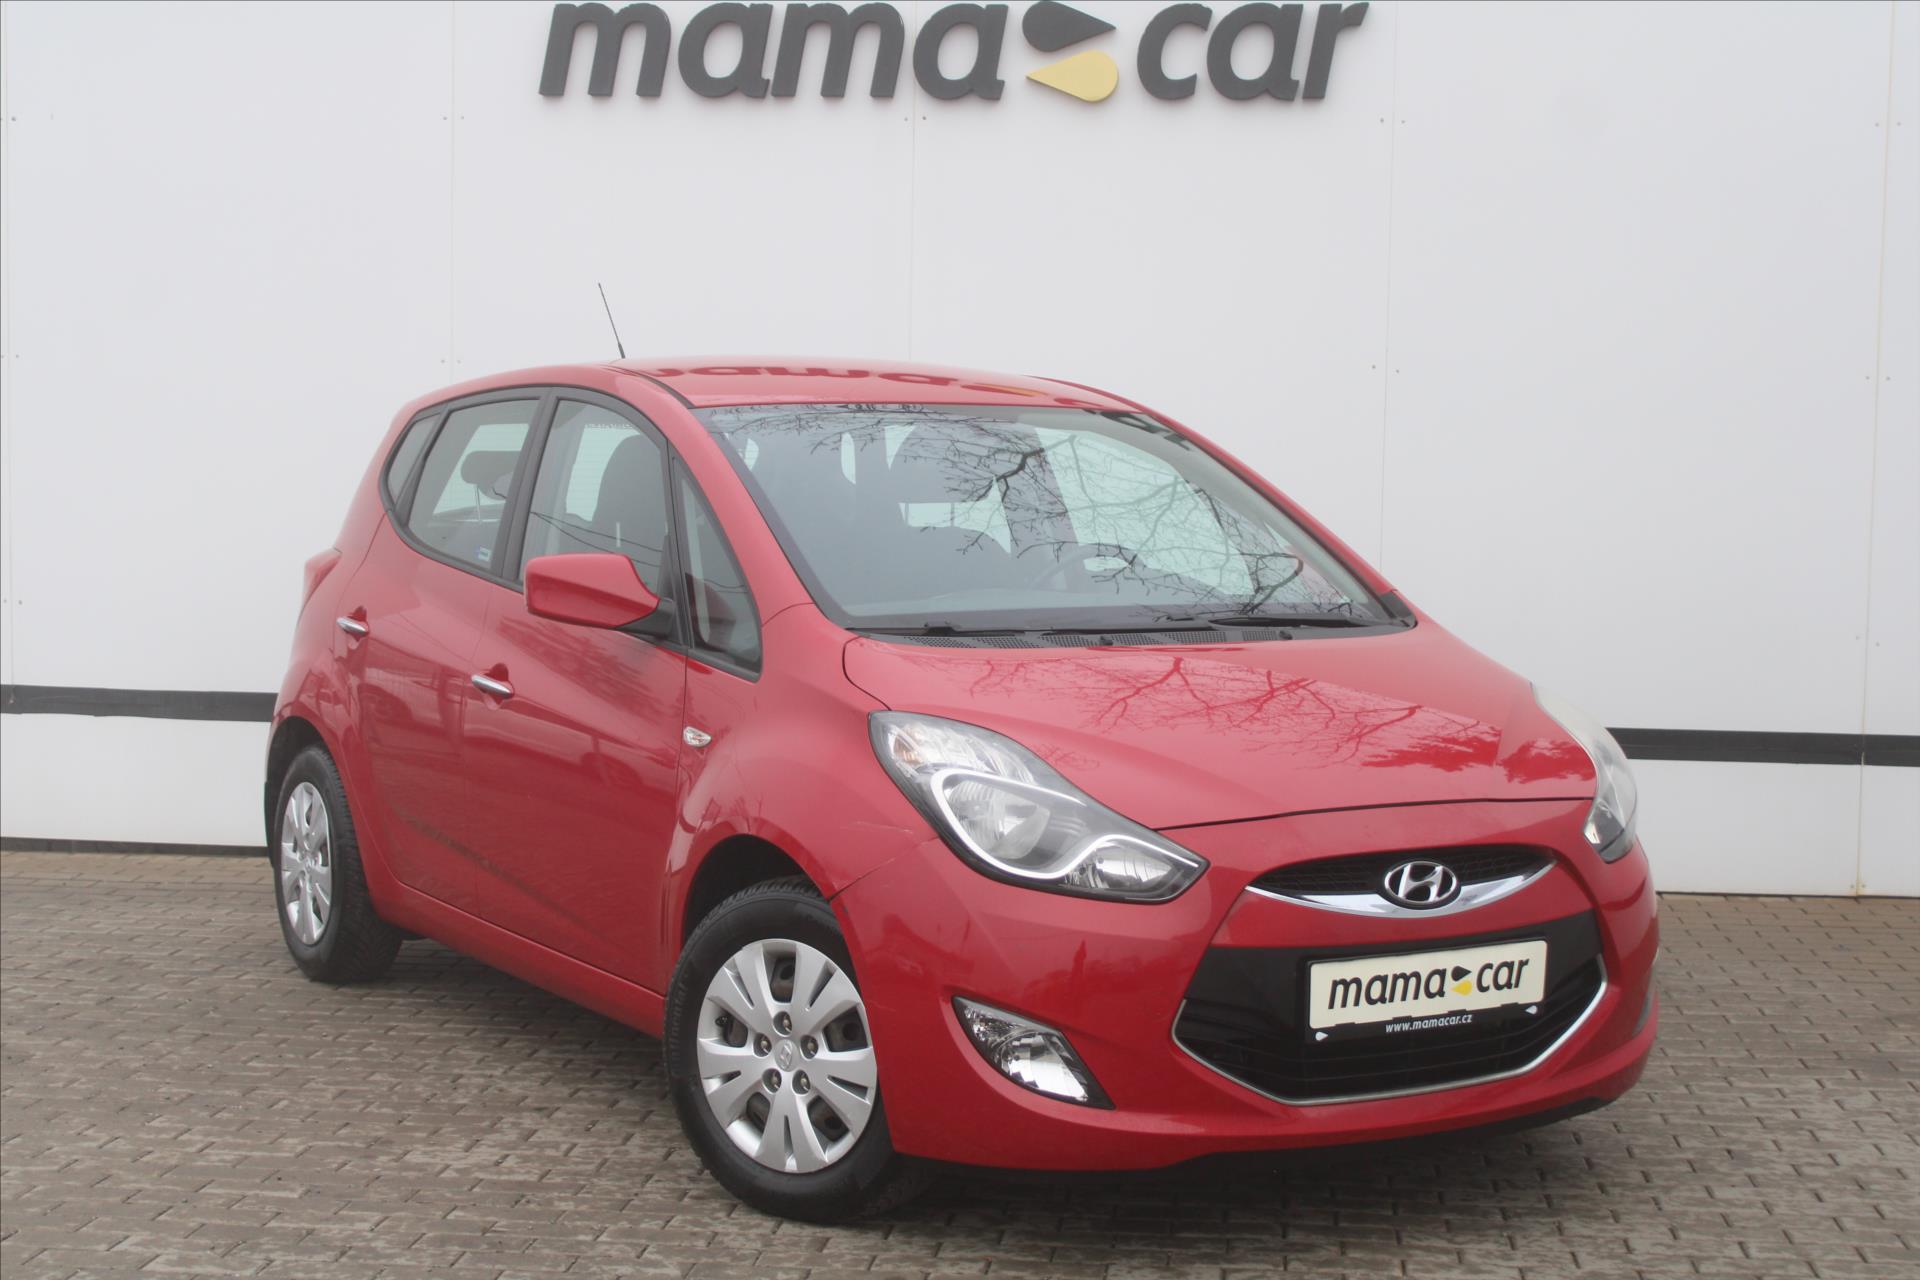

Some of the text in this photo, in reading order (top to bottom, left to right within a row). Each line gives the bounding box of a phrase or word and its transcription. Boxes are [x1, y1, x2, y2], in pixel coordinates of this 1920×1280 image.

[539, 2, 1369, 101] mama car
[1328, 958, 1530, 1010] mama car
[1385, 1013, 1473, 1033] www.mamacar.cz
